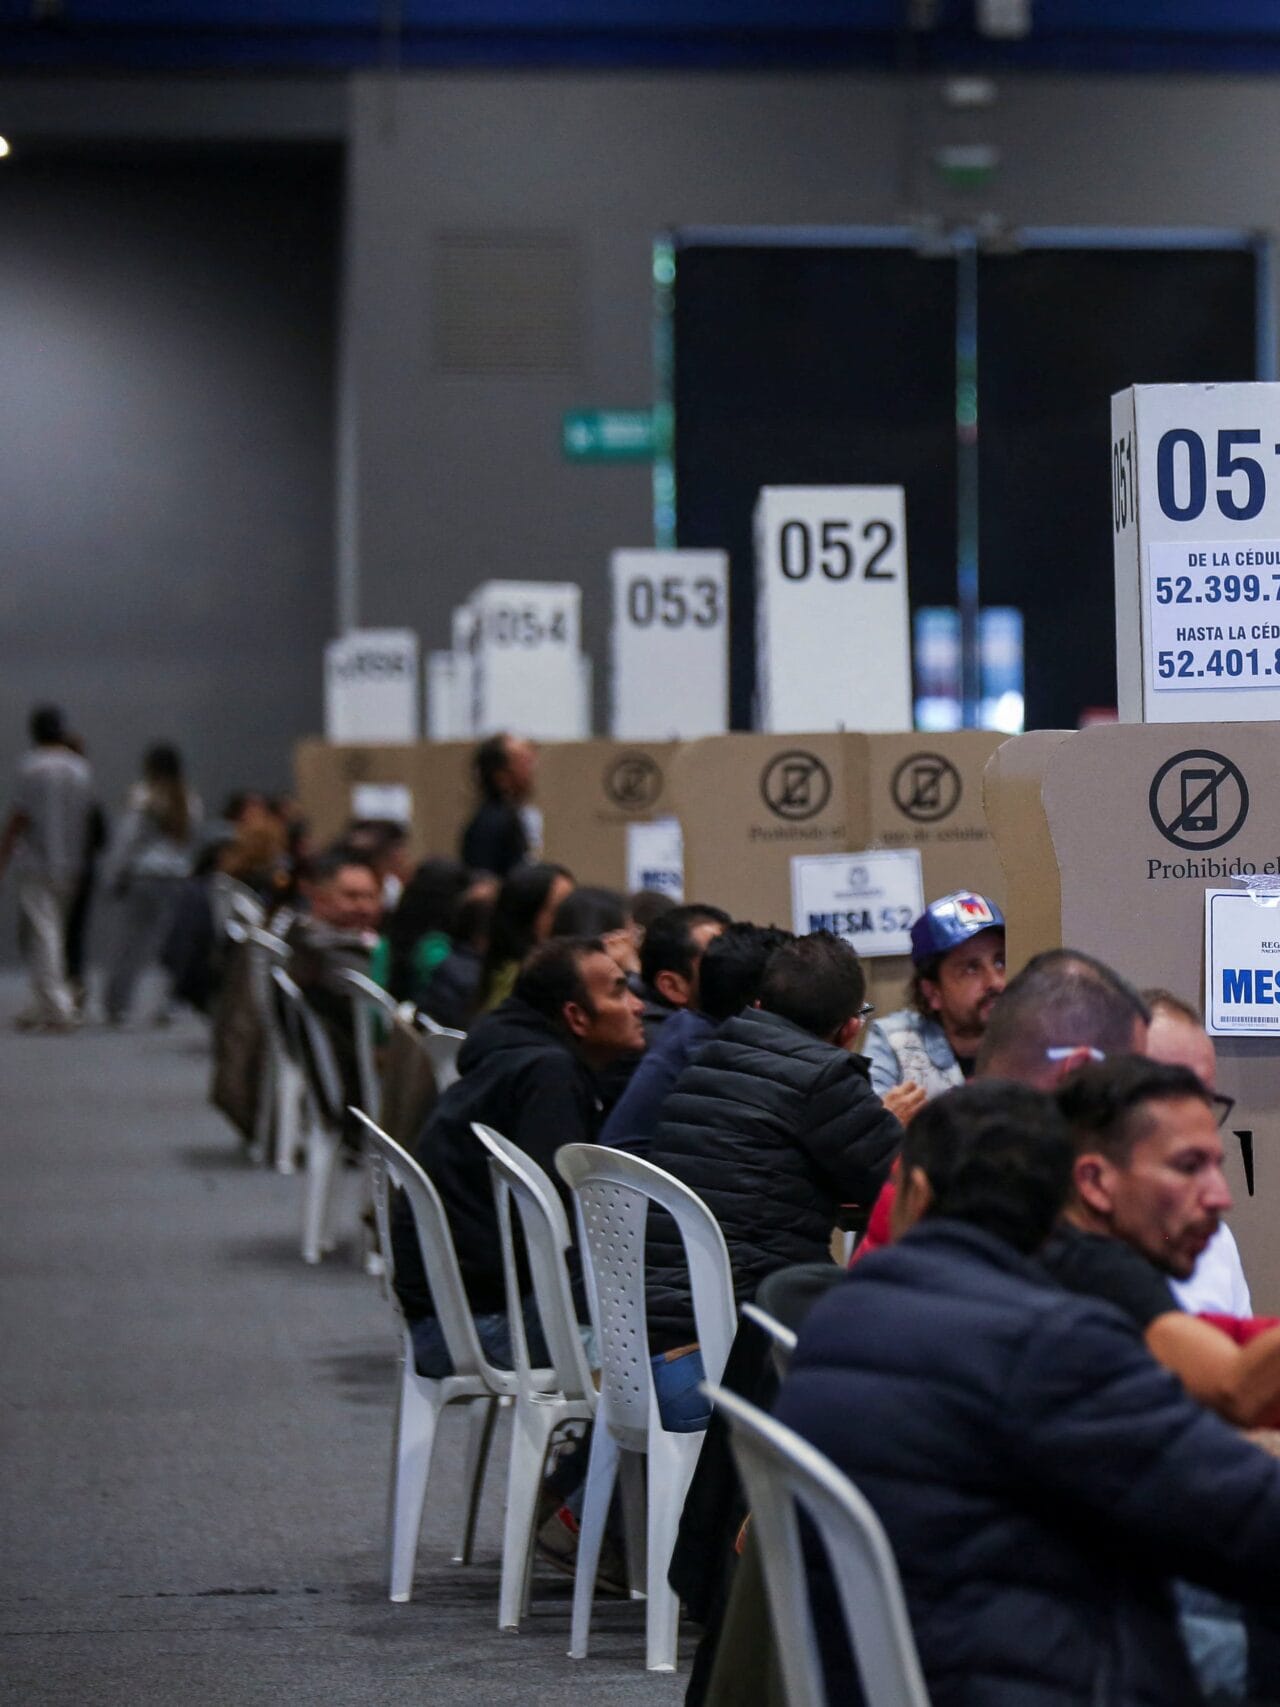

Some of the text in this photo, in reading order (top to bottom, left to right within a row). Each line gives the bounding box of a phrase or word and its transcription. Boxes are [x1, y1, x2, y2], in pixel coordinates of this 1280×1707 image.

[1114, 431, 1134, 533] 051
[779, 520, 896, 582] 052
[1188, 553, 1207, 567] DE
[1212, 552, 1230, 567] LA
[626, 576, 720, 629] 053
[1176, 627, 1224, 642] HASTA
[1228, 626, 1246, 641] LA
[1147, 857, 1256, 879] Prohibido
[809, 907, 912, 936] MESA 52
